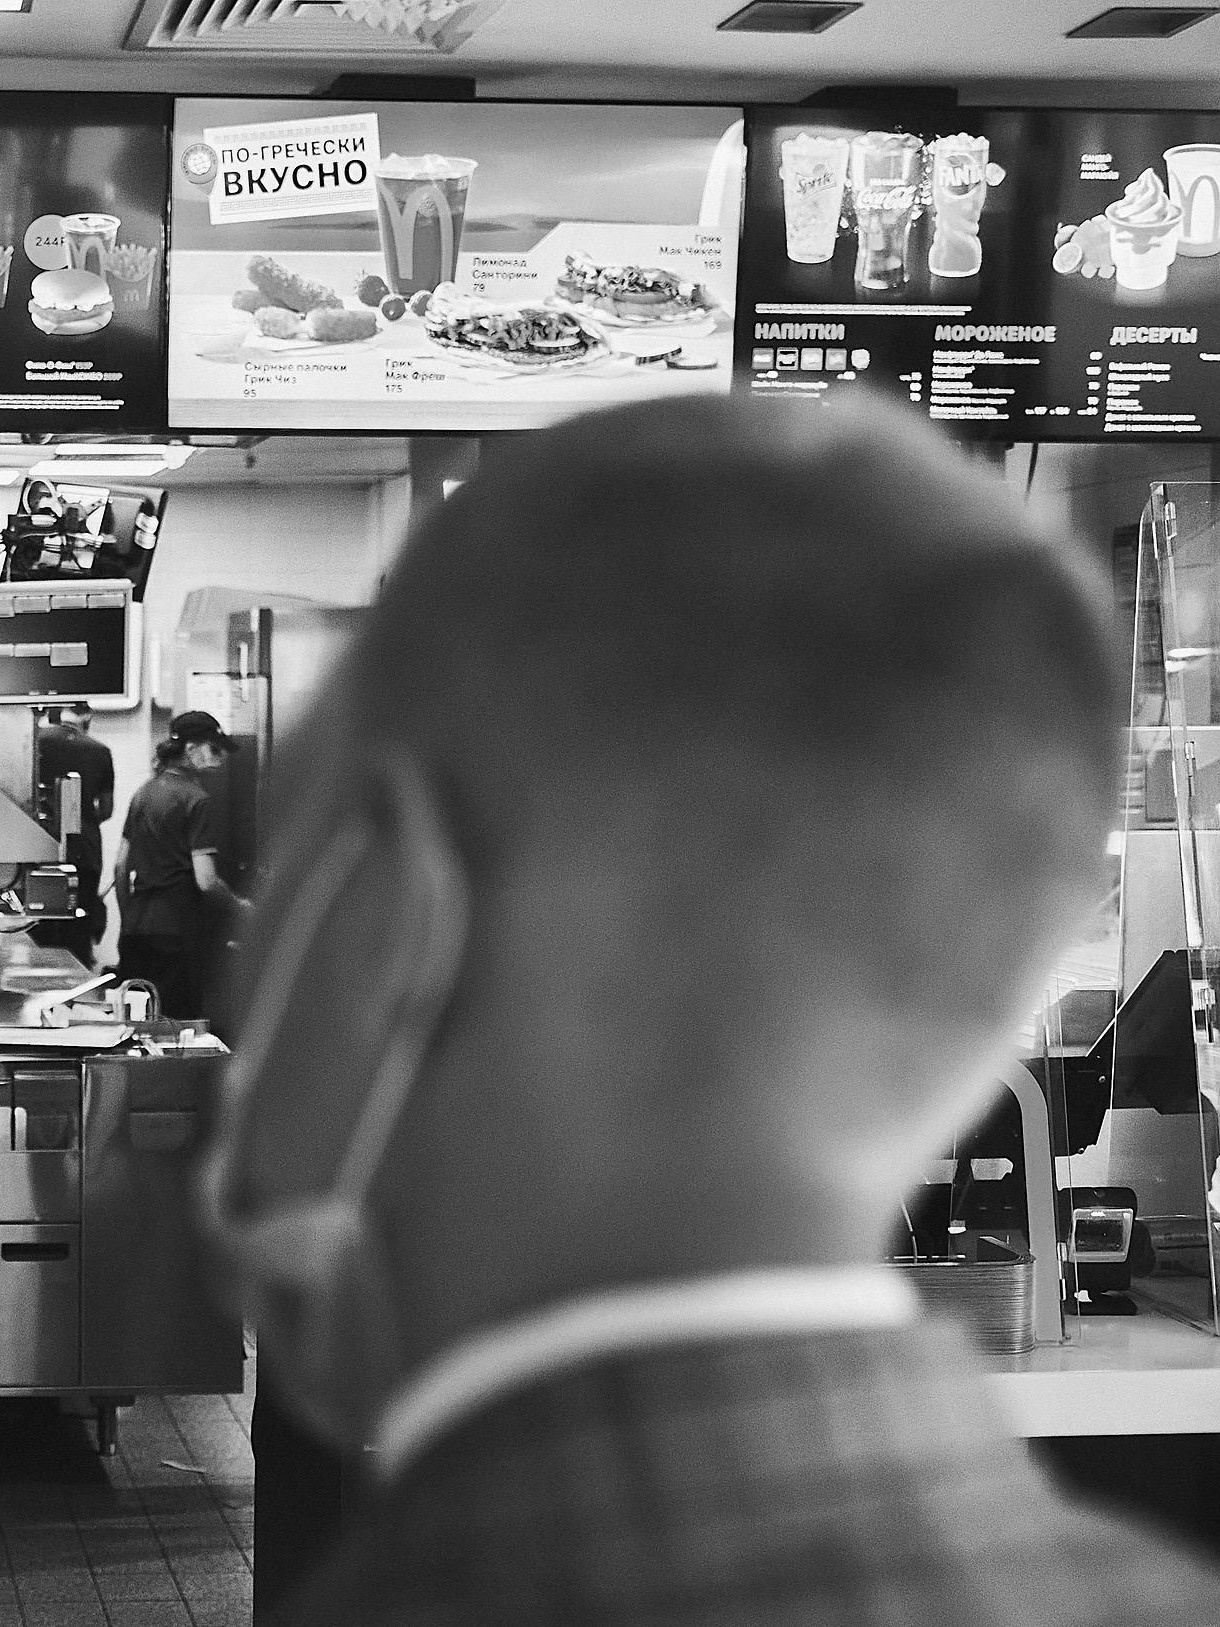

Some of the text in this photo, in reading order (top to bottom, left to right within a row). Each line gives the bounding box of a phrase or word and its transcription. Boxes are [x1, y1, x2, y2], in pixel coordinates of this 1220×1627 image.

[221, 137, 366, 164] ПО-ГРЕЧЕСКИ
[223, 159, 368, 197] ВКУСНО
[694, 234, 722, 245] Грик
[659, 246, 683, 256] Мак
[472, 257, 528, 269] Лимонад
[472, 270, 539, 281] Санторини
[754, 322, 845, 341] НАПИТКИ
[934, 325, 1056, 343] МОРОЖЕНОЕ
[1109, 326, 1198, 346] ДЕСЕРТЫ
[244, 362, 348, 374] Сырные палочки
[385, 358, 415, 370] Грик
[244, 374, 297, 386] Грик Чиз
[385, 371, 446, 383] Мак Фреш
[243, 388, 257, 398] 95
[385, 384, 403, 393] 175
